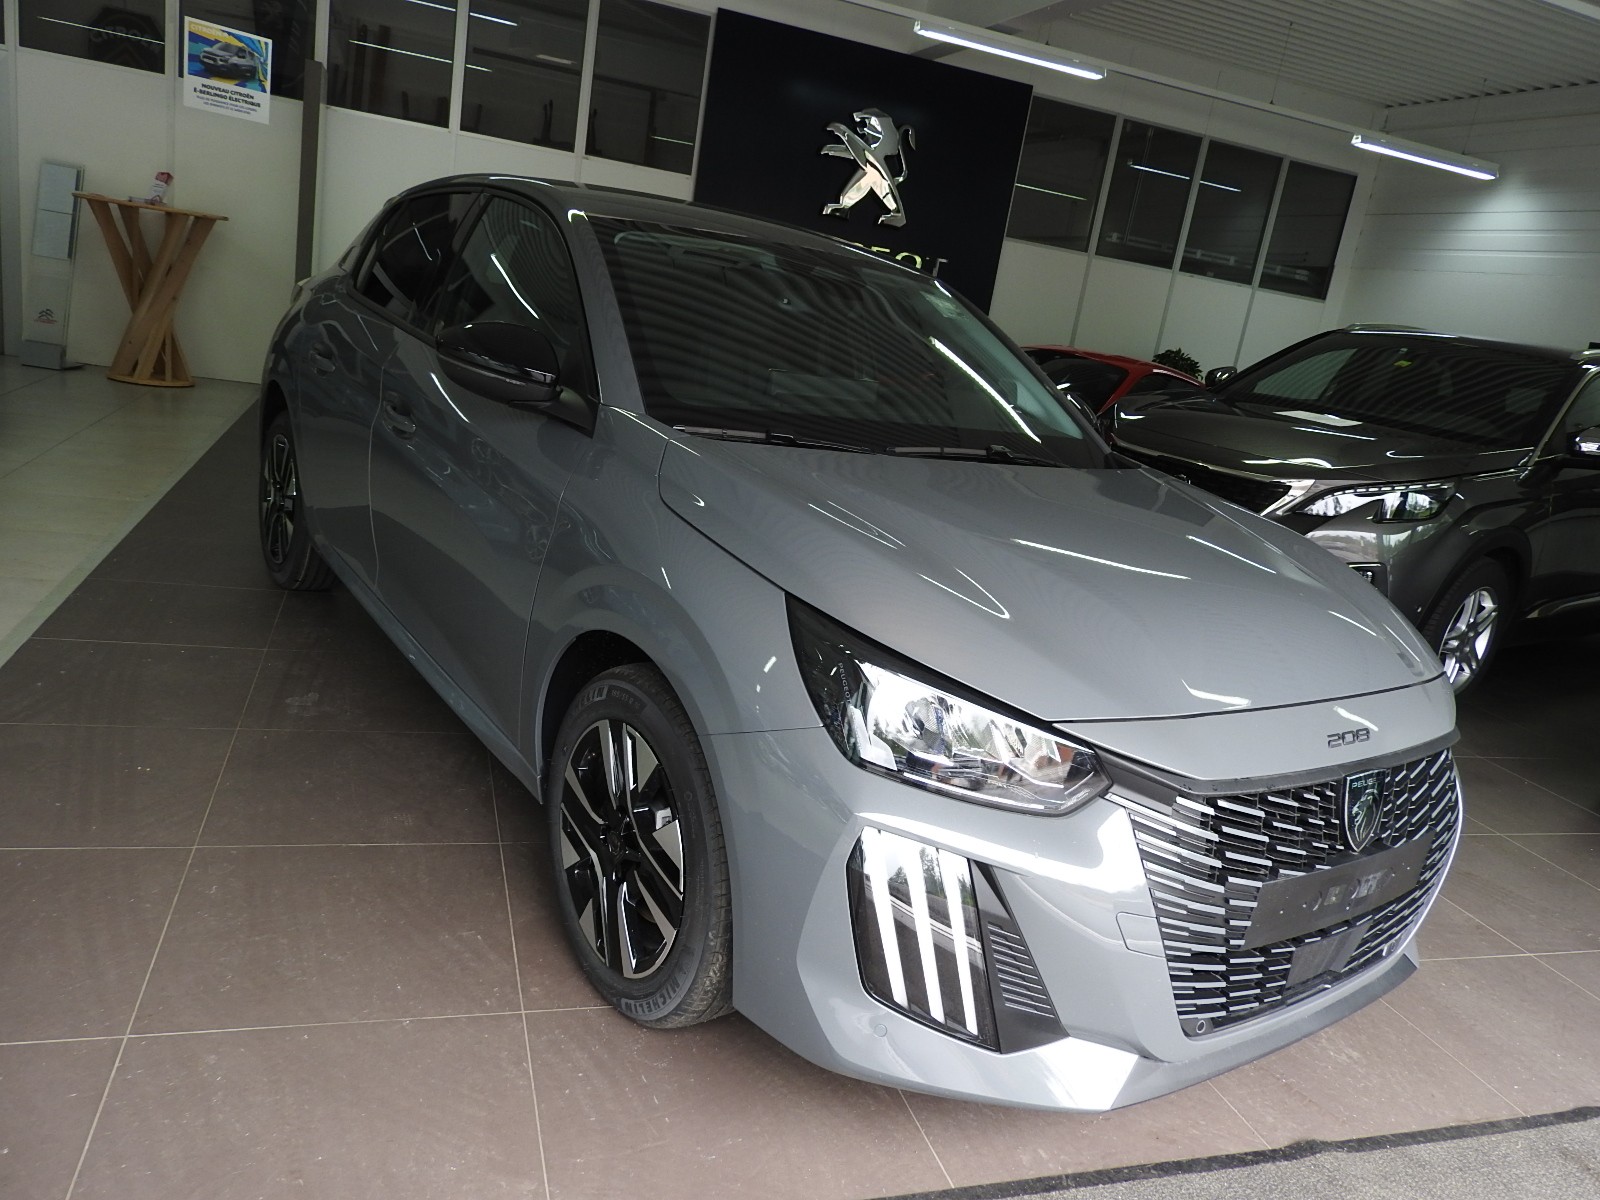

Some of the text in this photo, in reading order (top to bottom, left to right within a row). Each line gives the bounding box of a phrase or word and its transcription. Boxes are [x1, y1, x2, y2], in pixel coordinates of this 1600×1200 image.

[201, 83, 230, 94] NOUVEAU
[838, 662, 852, 704] PEUGEOT
[1327, 727, 1370, 748] 208
[623, 976, 681, 1014] MICHELIN
